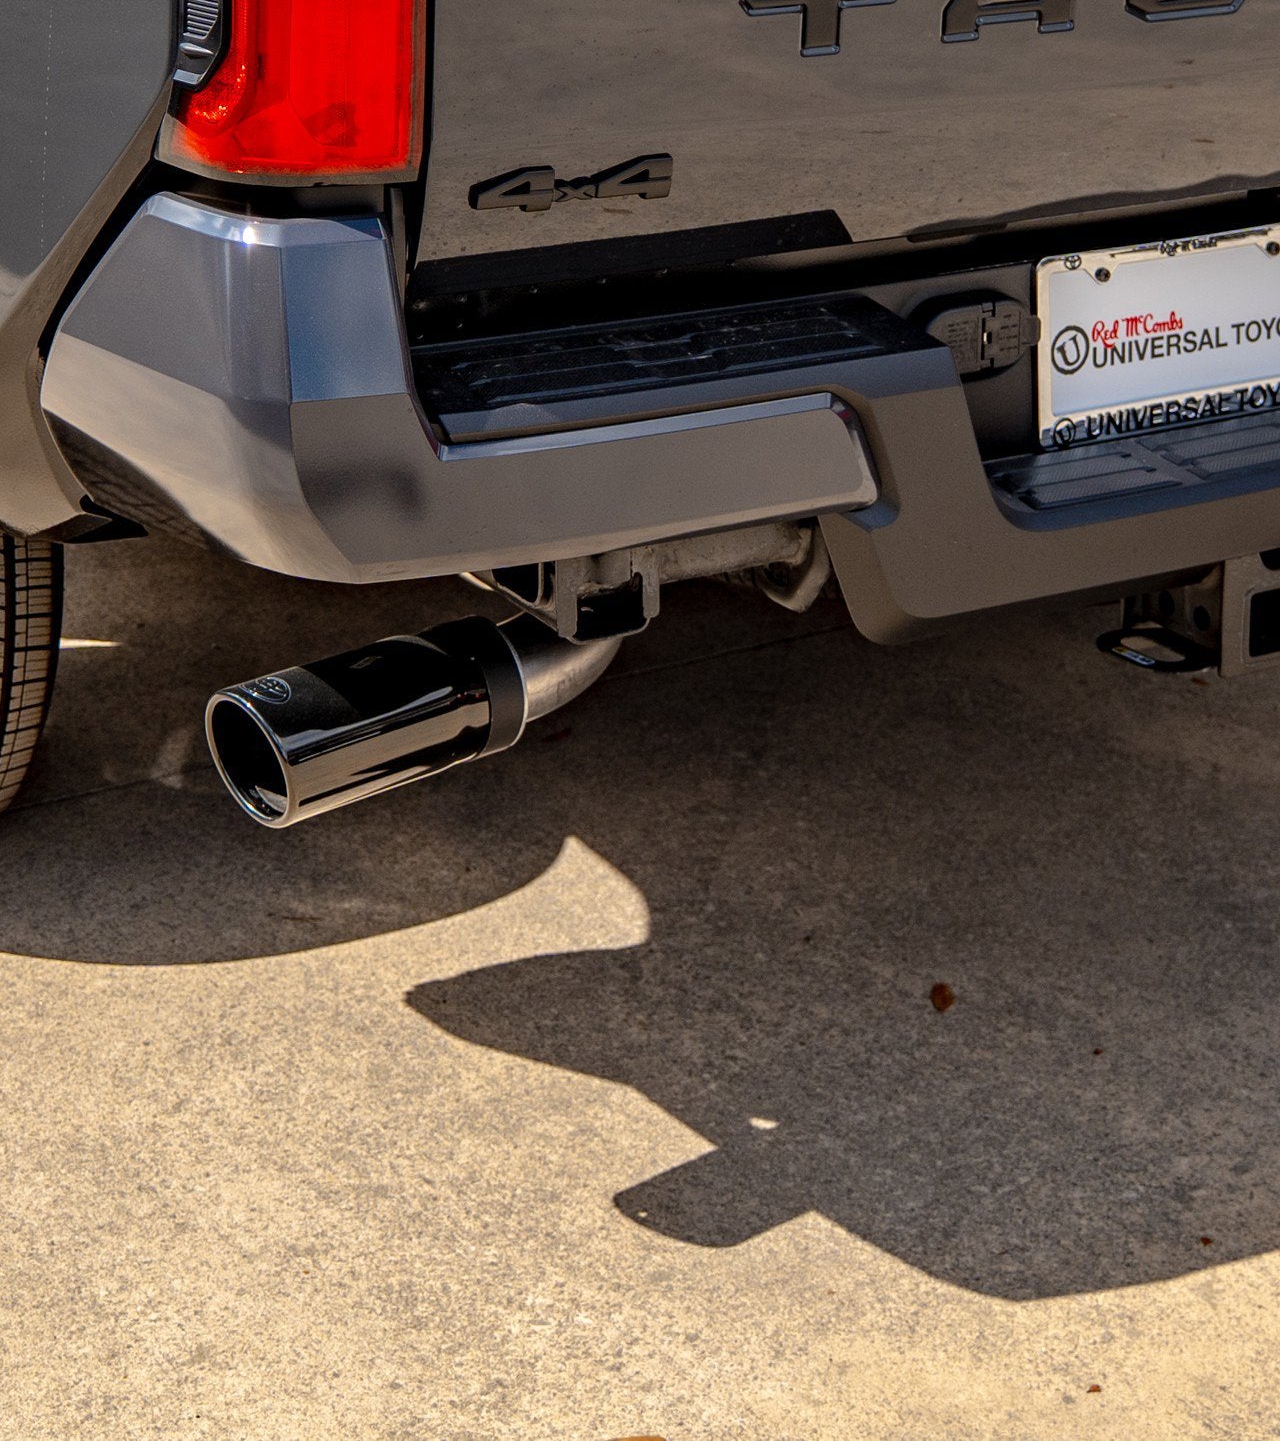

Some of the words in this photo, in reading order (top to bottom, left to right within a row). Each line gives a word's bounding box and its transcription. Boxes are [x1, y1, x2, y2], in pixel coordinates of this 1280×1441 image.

[1091, 320, 1119, 348] Red
[1120, 310, 1183, 338] McCombs
[1092, 326, 1229, 369] UNIVERSAL
[1085, 391, 1231, 439] UNIVERSAL
